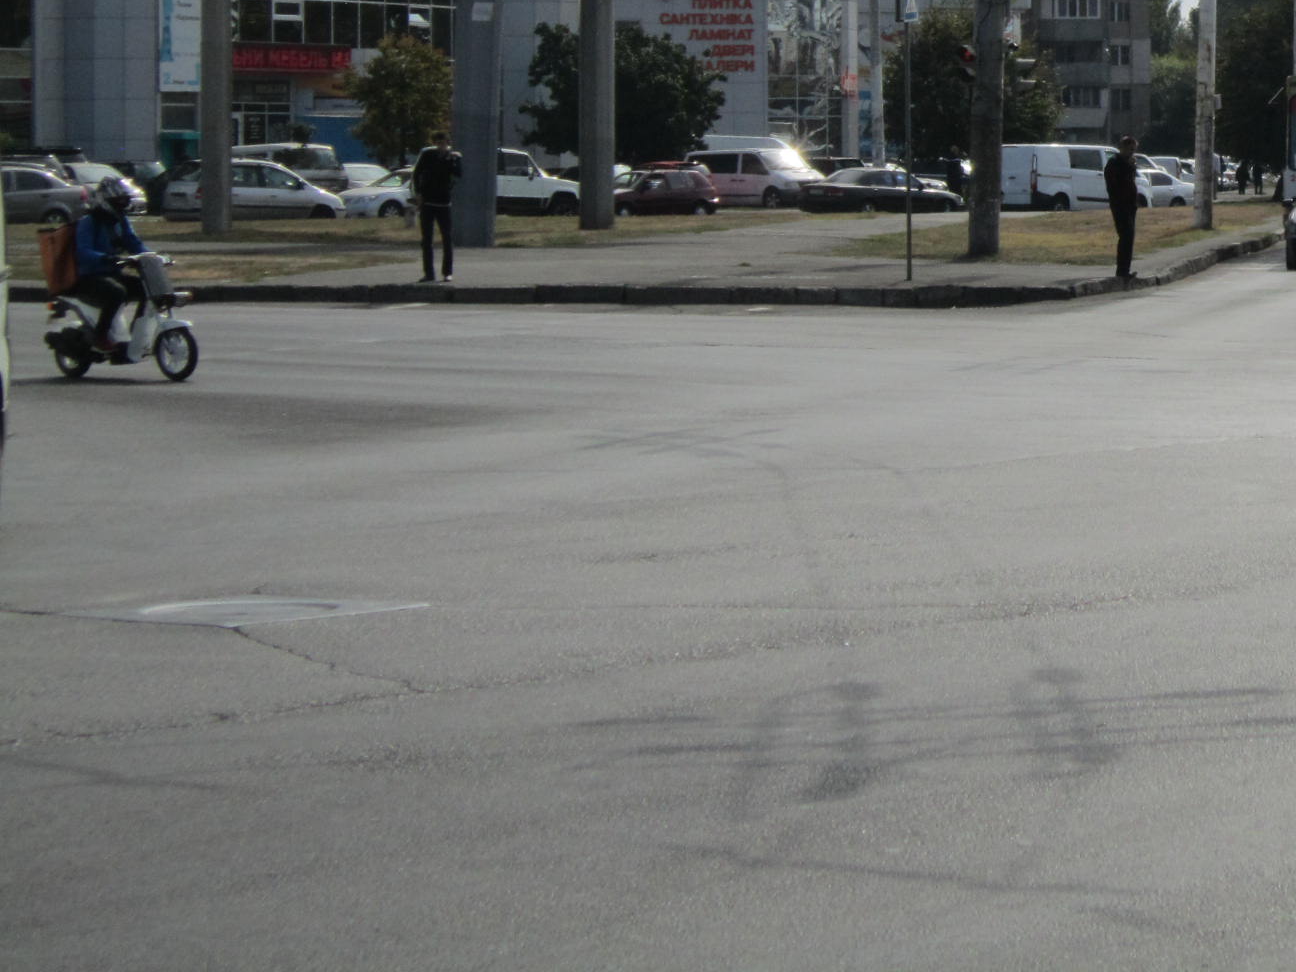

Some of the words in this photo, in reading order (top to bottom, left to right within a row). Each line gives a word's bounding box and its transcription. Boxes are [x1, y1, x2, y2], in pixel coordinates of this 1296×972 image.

[659, 13, 754, 25] САНТЕХНІКА
[689, 29, 754, 40] ЛАМІНАТ
[712, 44, 755, 57] ДВЕРІ
[268, 50, 329, 69] МЕБЕЛЬ
